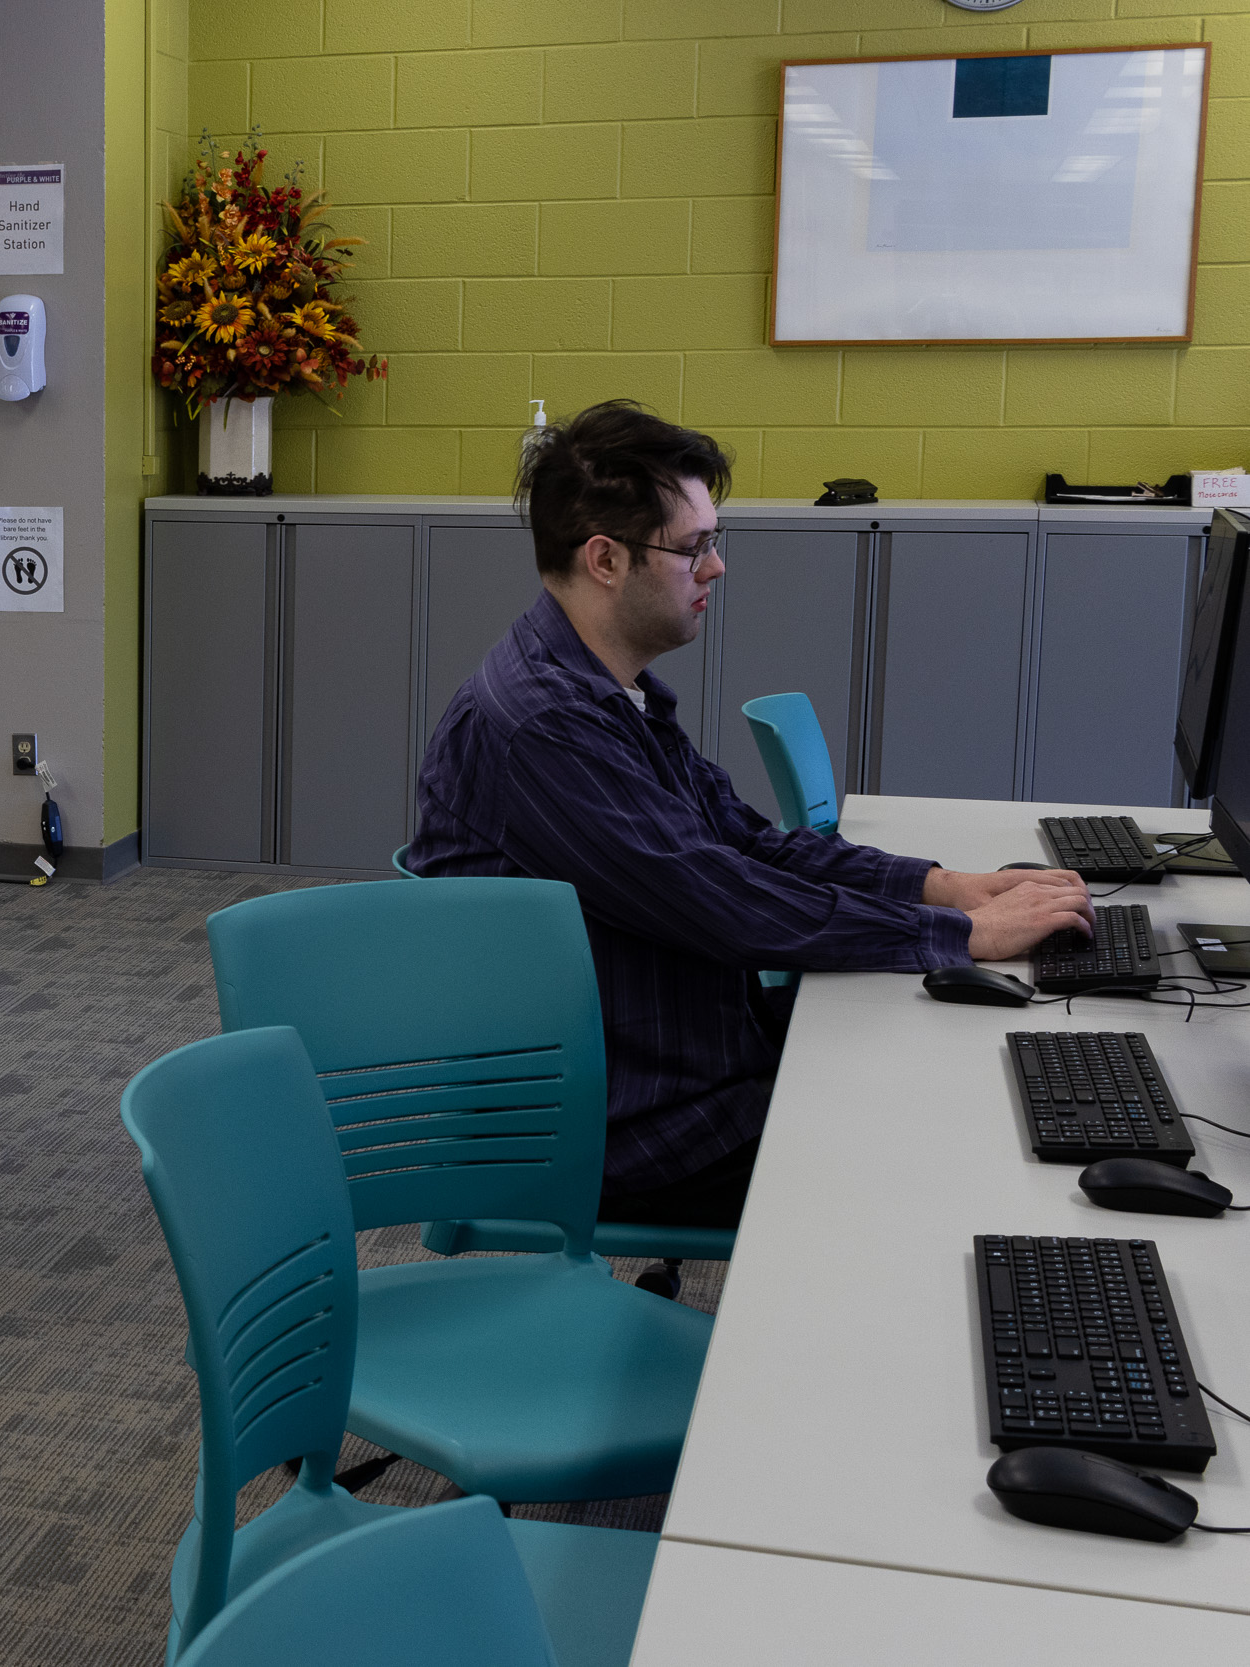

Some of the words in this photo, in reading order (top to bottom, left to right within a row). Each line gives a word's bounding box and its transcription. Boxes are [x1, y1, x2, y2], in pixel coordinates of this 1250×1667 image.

[10, 200, 40, 211] Hand
[4, 239, 45, 249] Station
[1203, 478, 1238, 488] FREE
